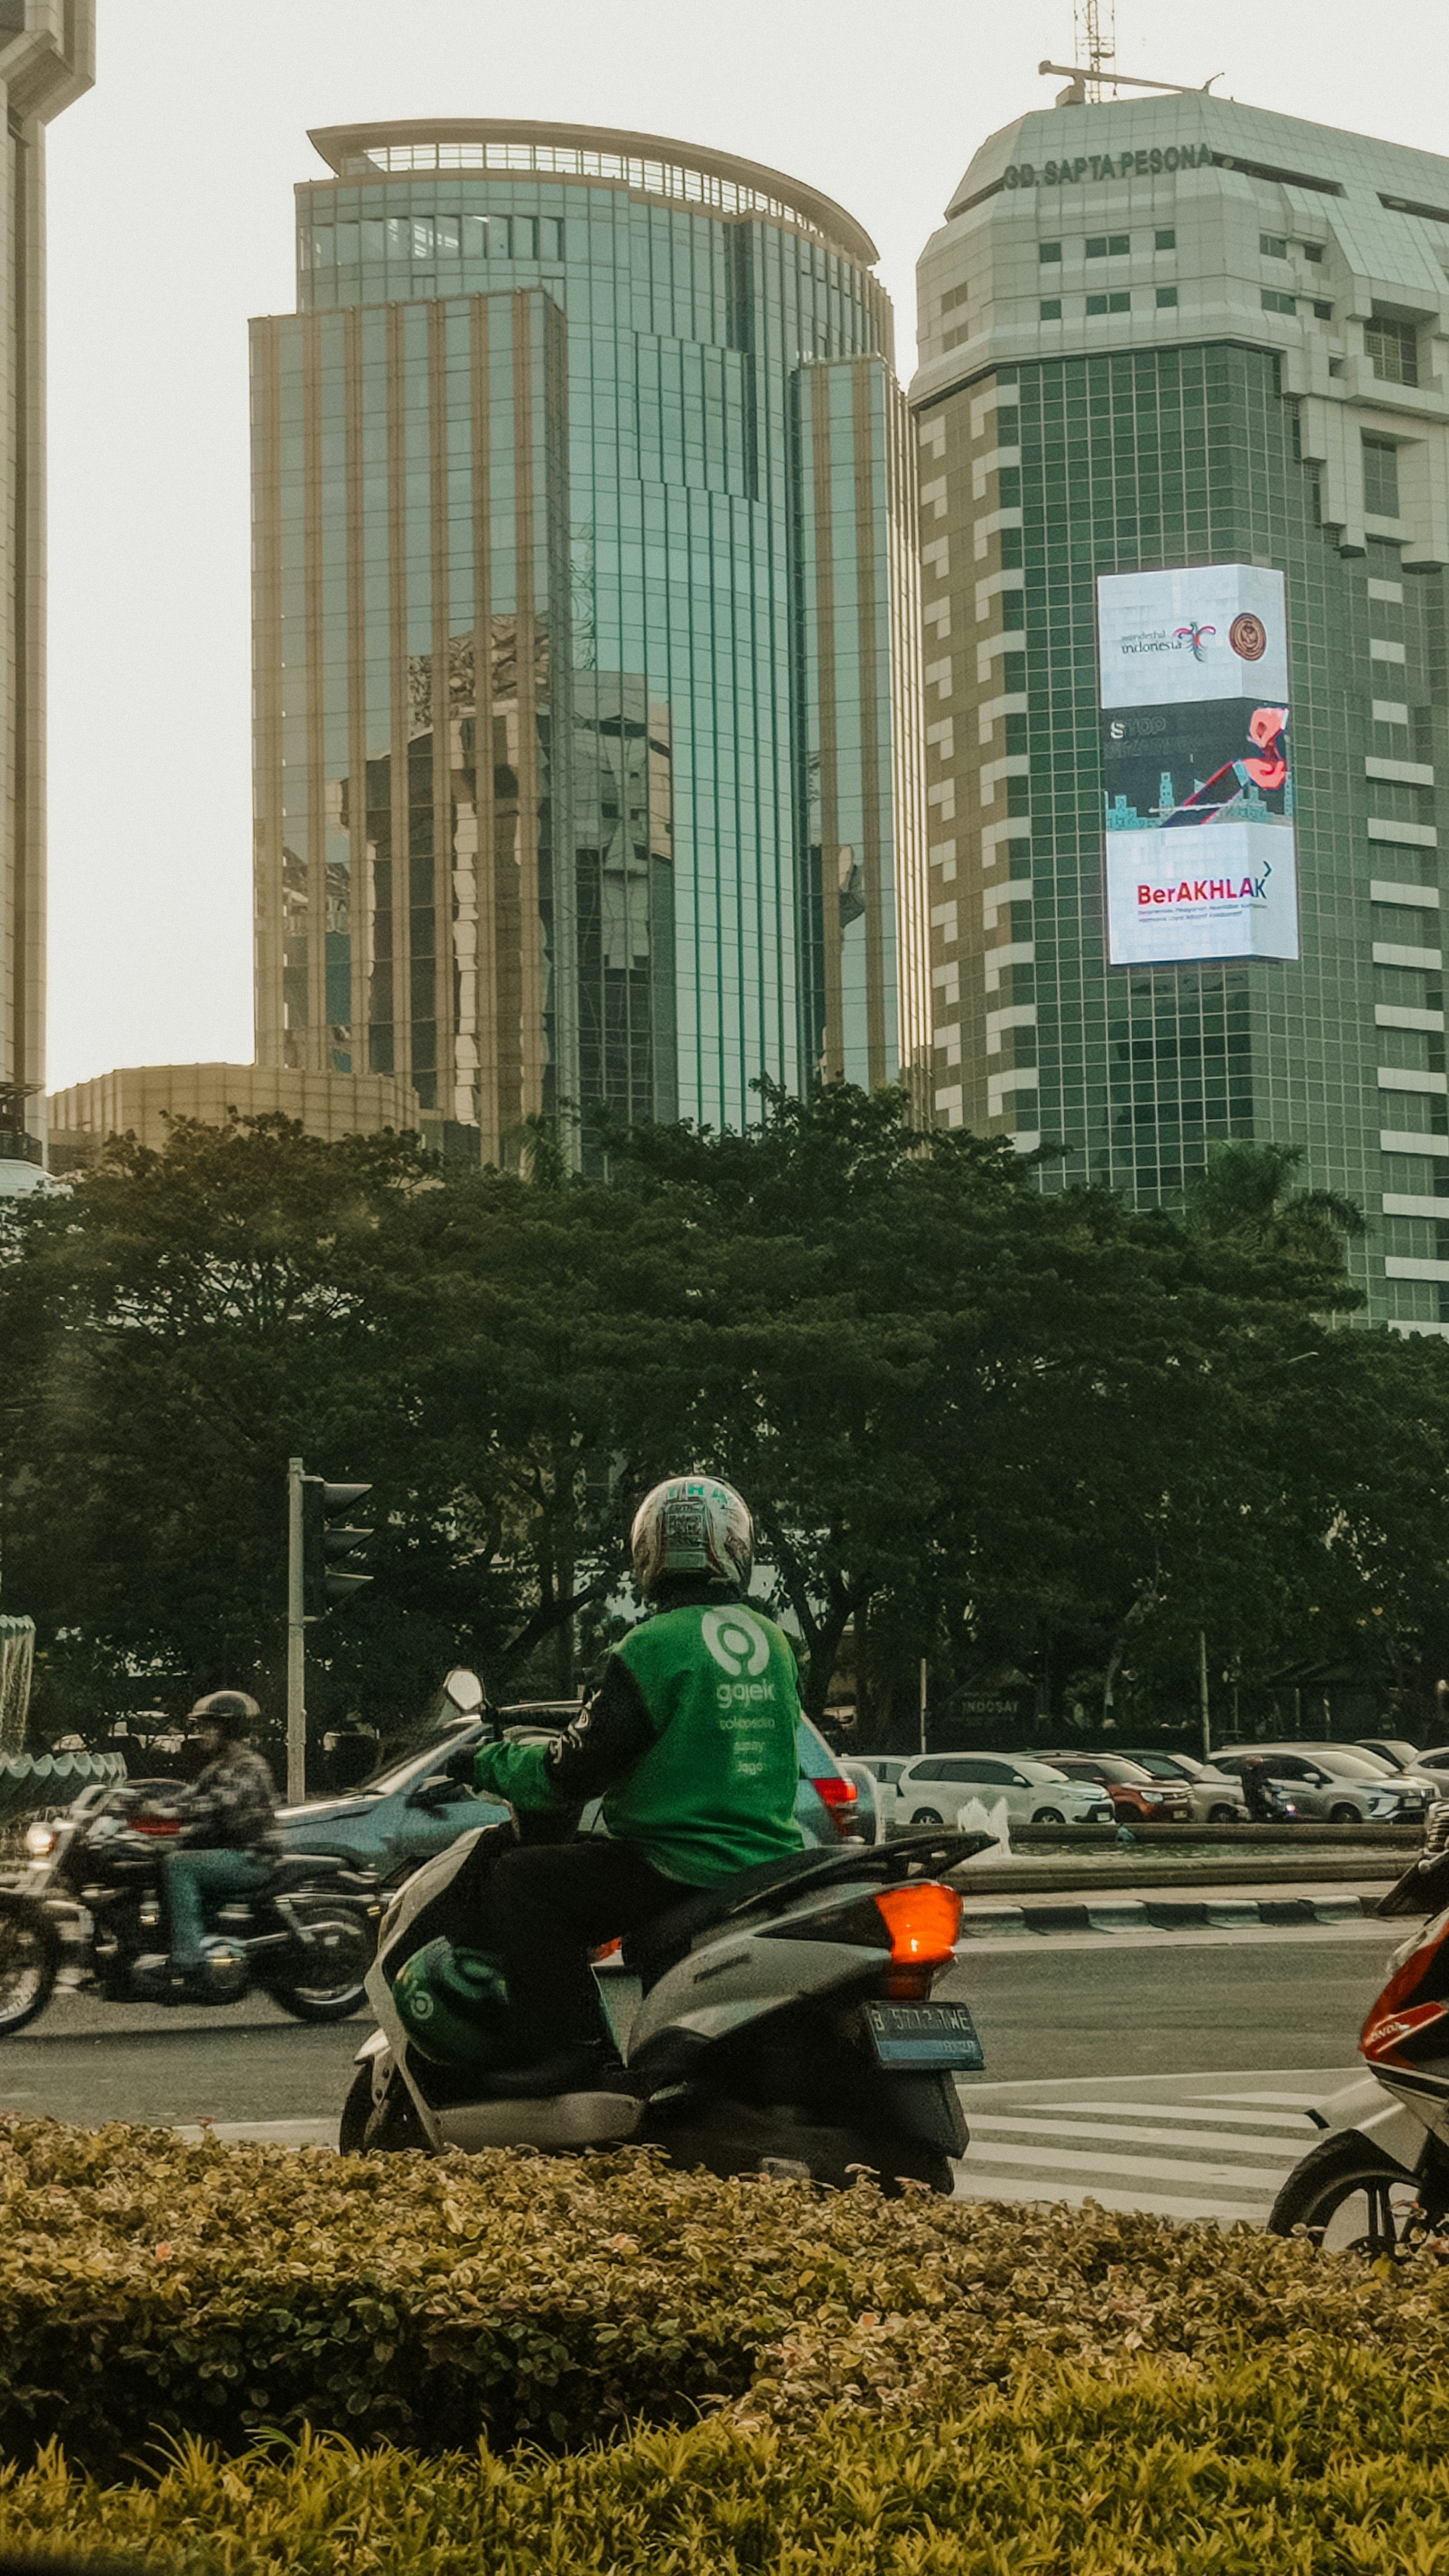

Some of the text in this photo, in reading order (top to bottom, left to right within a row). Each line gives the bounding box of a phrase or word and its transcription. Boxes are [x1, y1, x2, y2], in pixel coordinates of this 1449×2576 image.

[1044, 154, 1115, 185] SAPTA
[1120, 143, 1212, 179] PESONA
[1137, 877, 1266, 905] BerAKHLAK
[717, 1678, 775, 1708] gojek
[871, 2010, 885, 2031] B
